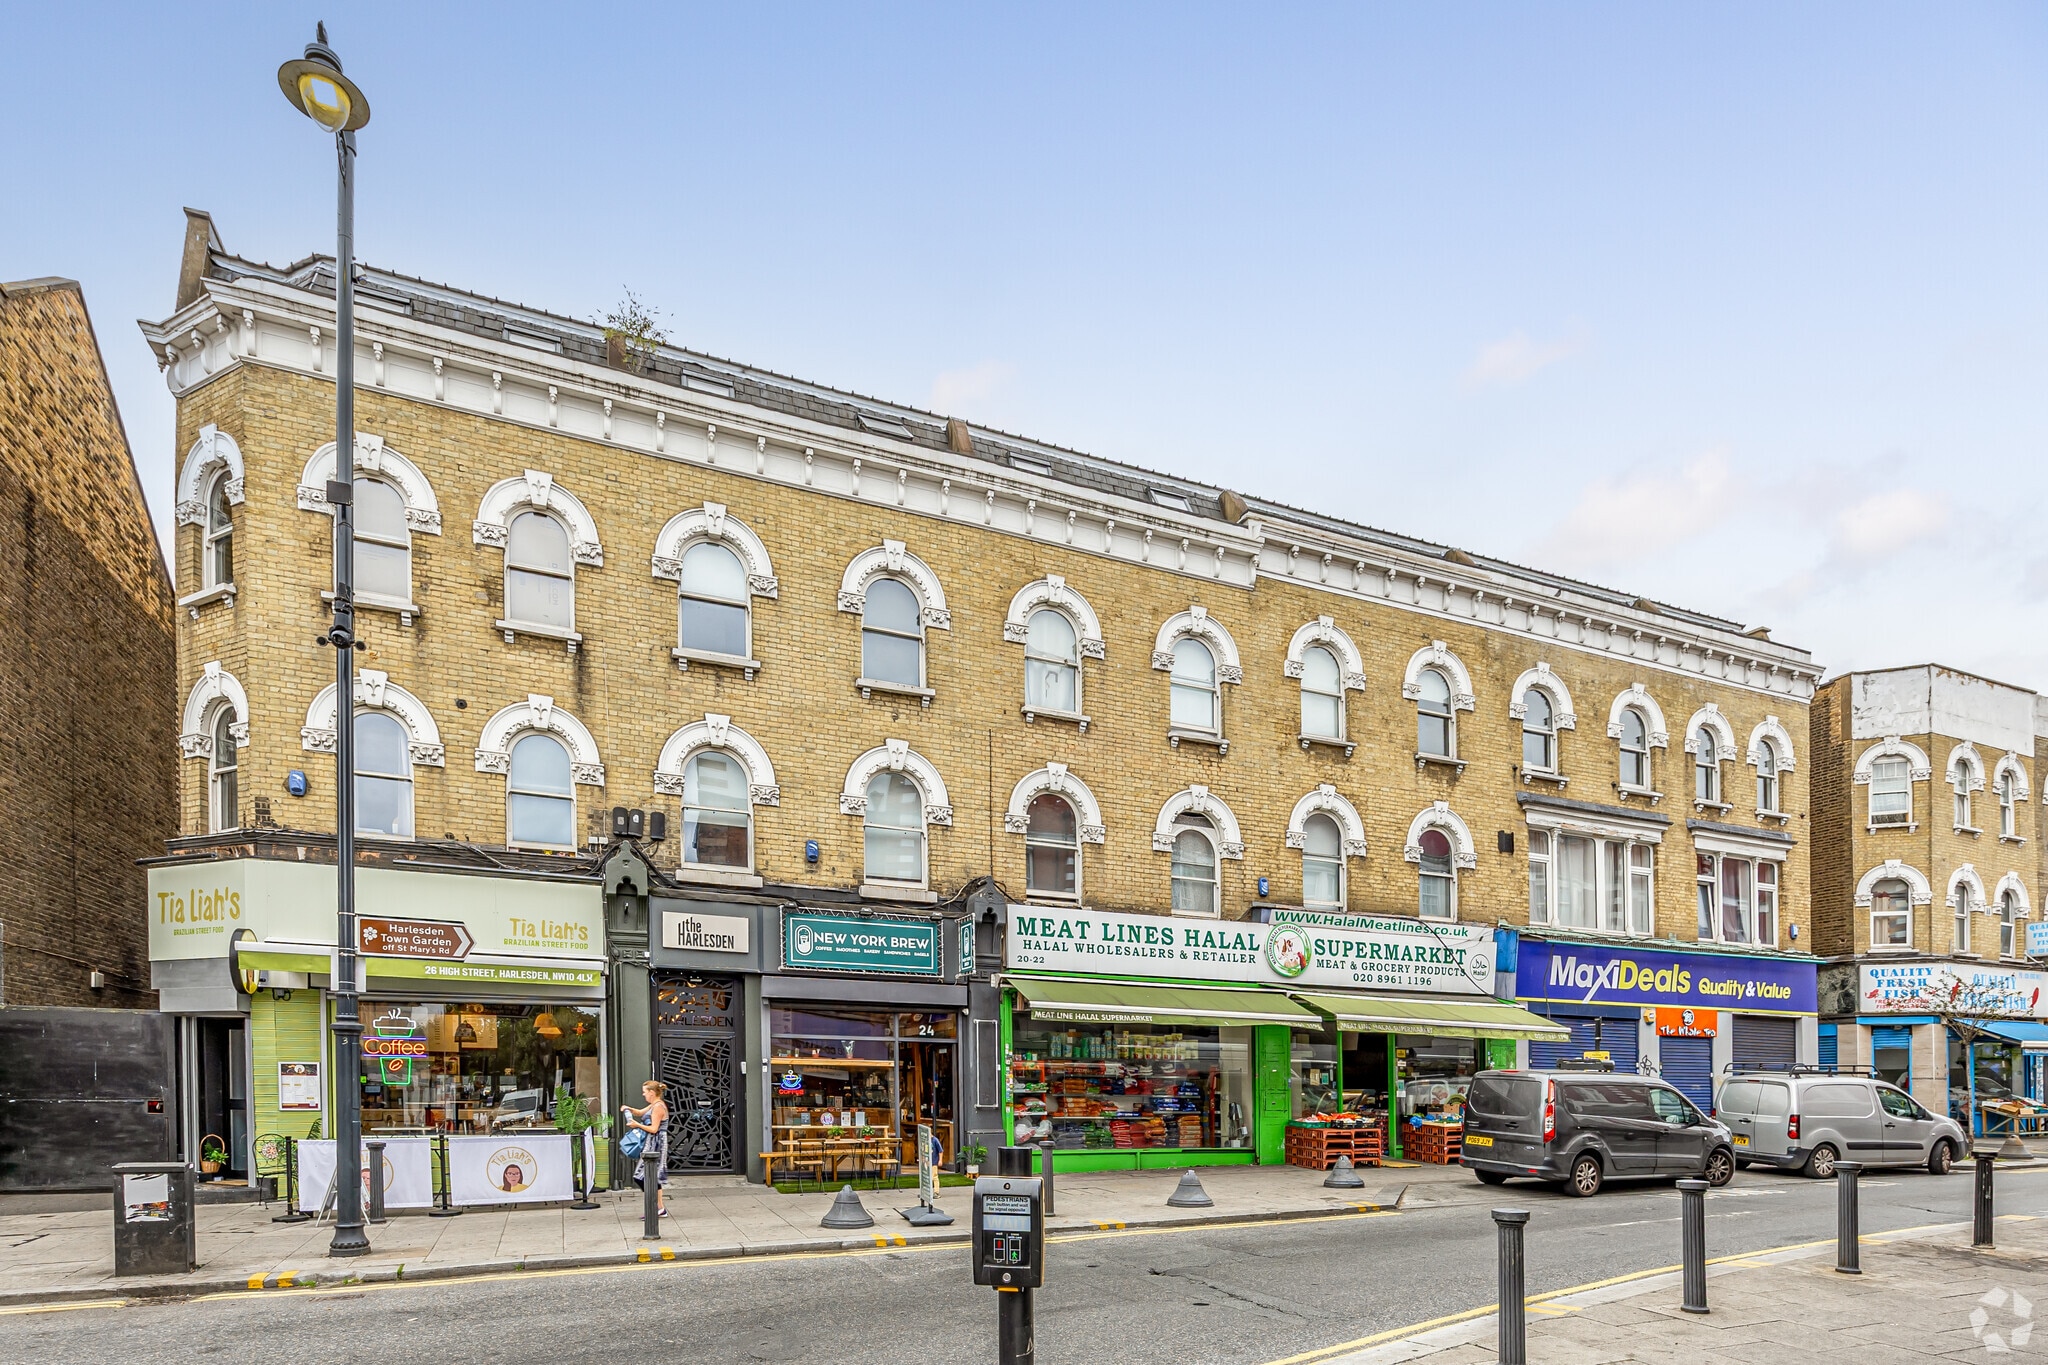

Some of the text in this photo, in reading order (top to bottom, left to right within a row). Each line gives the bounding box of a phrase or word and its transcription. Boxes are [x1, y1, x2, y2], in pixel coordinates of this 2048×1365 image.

[157, 886, 240, 924] Tia Liah's
[389, 923, 444, 936] Harlesden
[509, 917, 588, 941] Tia Liah's
[686, 917, 702, 932] the
[380, 933, 452, 947] Town Garden
[678, 920, 734, 949] HARLESDEN
[814, 932, 929, 950] NEW YORK BREW
[1016, 916, 1261, 952] MEAT LINES HALAL
[409, 946, 436, 955] Mary's
[503, 938, 540, 947] BRAZILIAN
[542, 941, 569, 949] STREET
[1023, 939, 1256, 964] HALAL WHOLESALERS & RETAILER
[1314, 938, 1467, 965] SUPERMARKET
[1017, 955, 1045, 963] 20-22
[424, 965, 438, 975] 26
[439, 966, 460, 976] HIGH
[462, 968, 498, 978] STREET,
[499, 969, 551, 981] HARLESDEN,
[552, 972, 574, 981] NW10
[1316, 959, 1466, 977] MEAT & GROCERY PRODUCTS
[1869, 967, 1934, 979] QUALITY
[1353, 974, 1432, 986] 020 8961 1196
[1549, 955, 1691, 1004] MaxiDeals
[1877, 978, 1928, 988] FRESH
[1884, 989, 1921, 998] FISH
[657, 1013, 734, 1027] HARLESDEN
[1035, 1010, 1055, 1018] MEAT
[1101, 1014, 1153, 1022] SUPERMARKET
[918, 1024, 935, 1036] 24
[1659, 1025, 1675, 1035] The
[364, 1038, 426, 1055] Coffee
[491, 1154, 506, 1166] Tia
